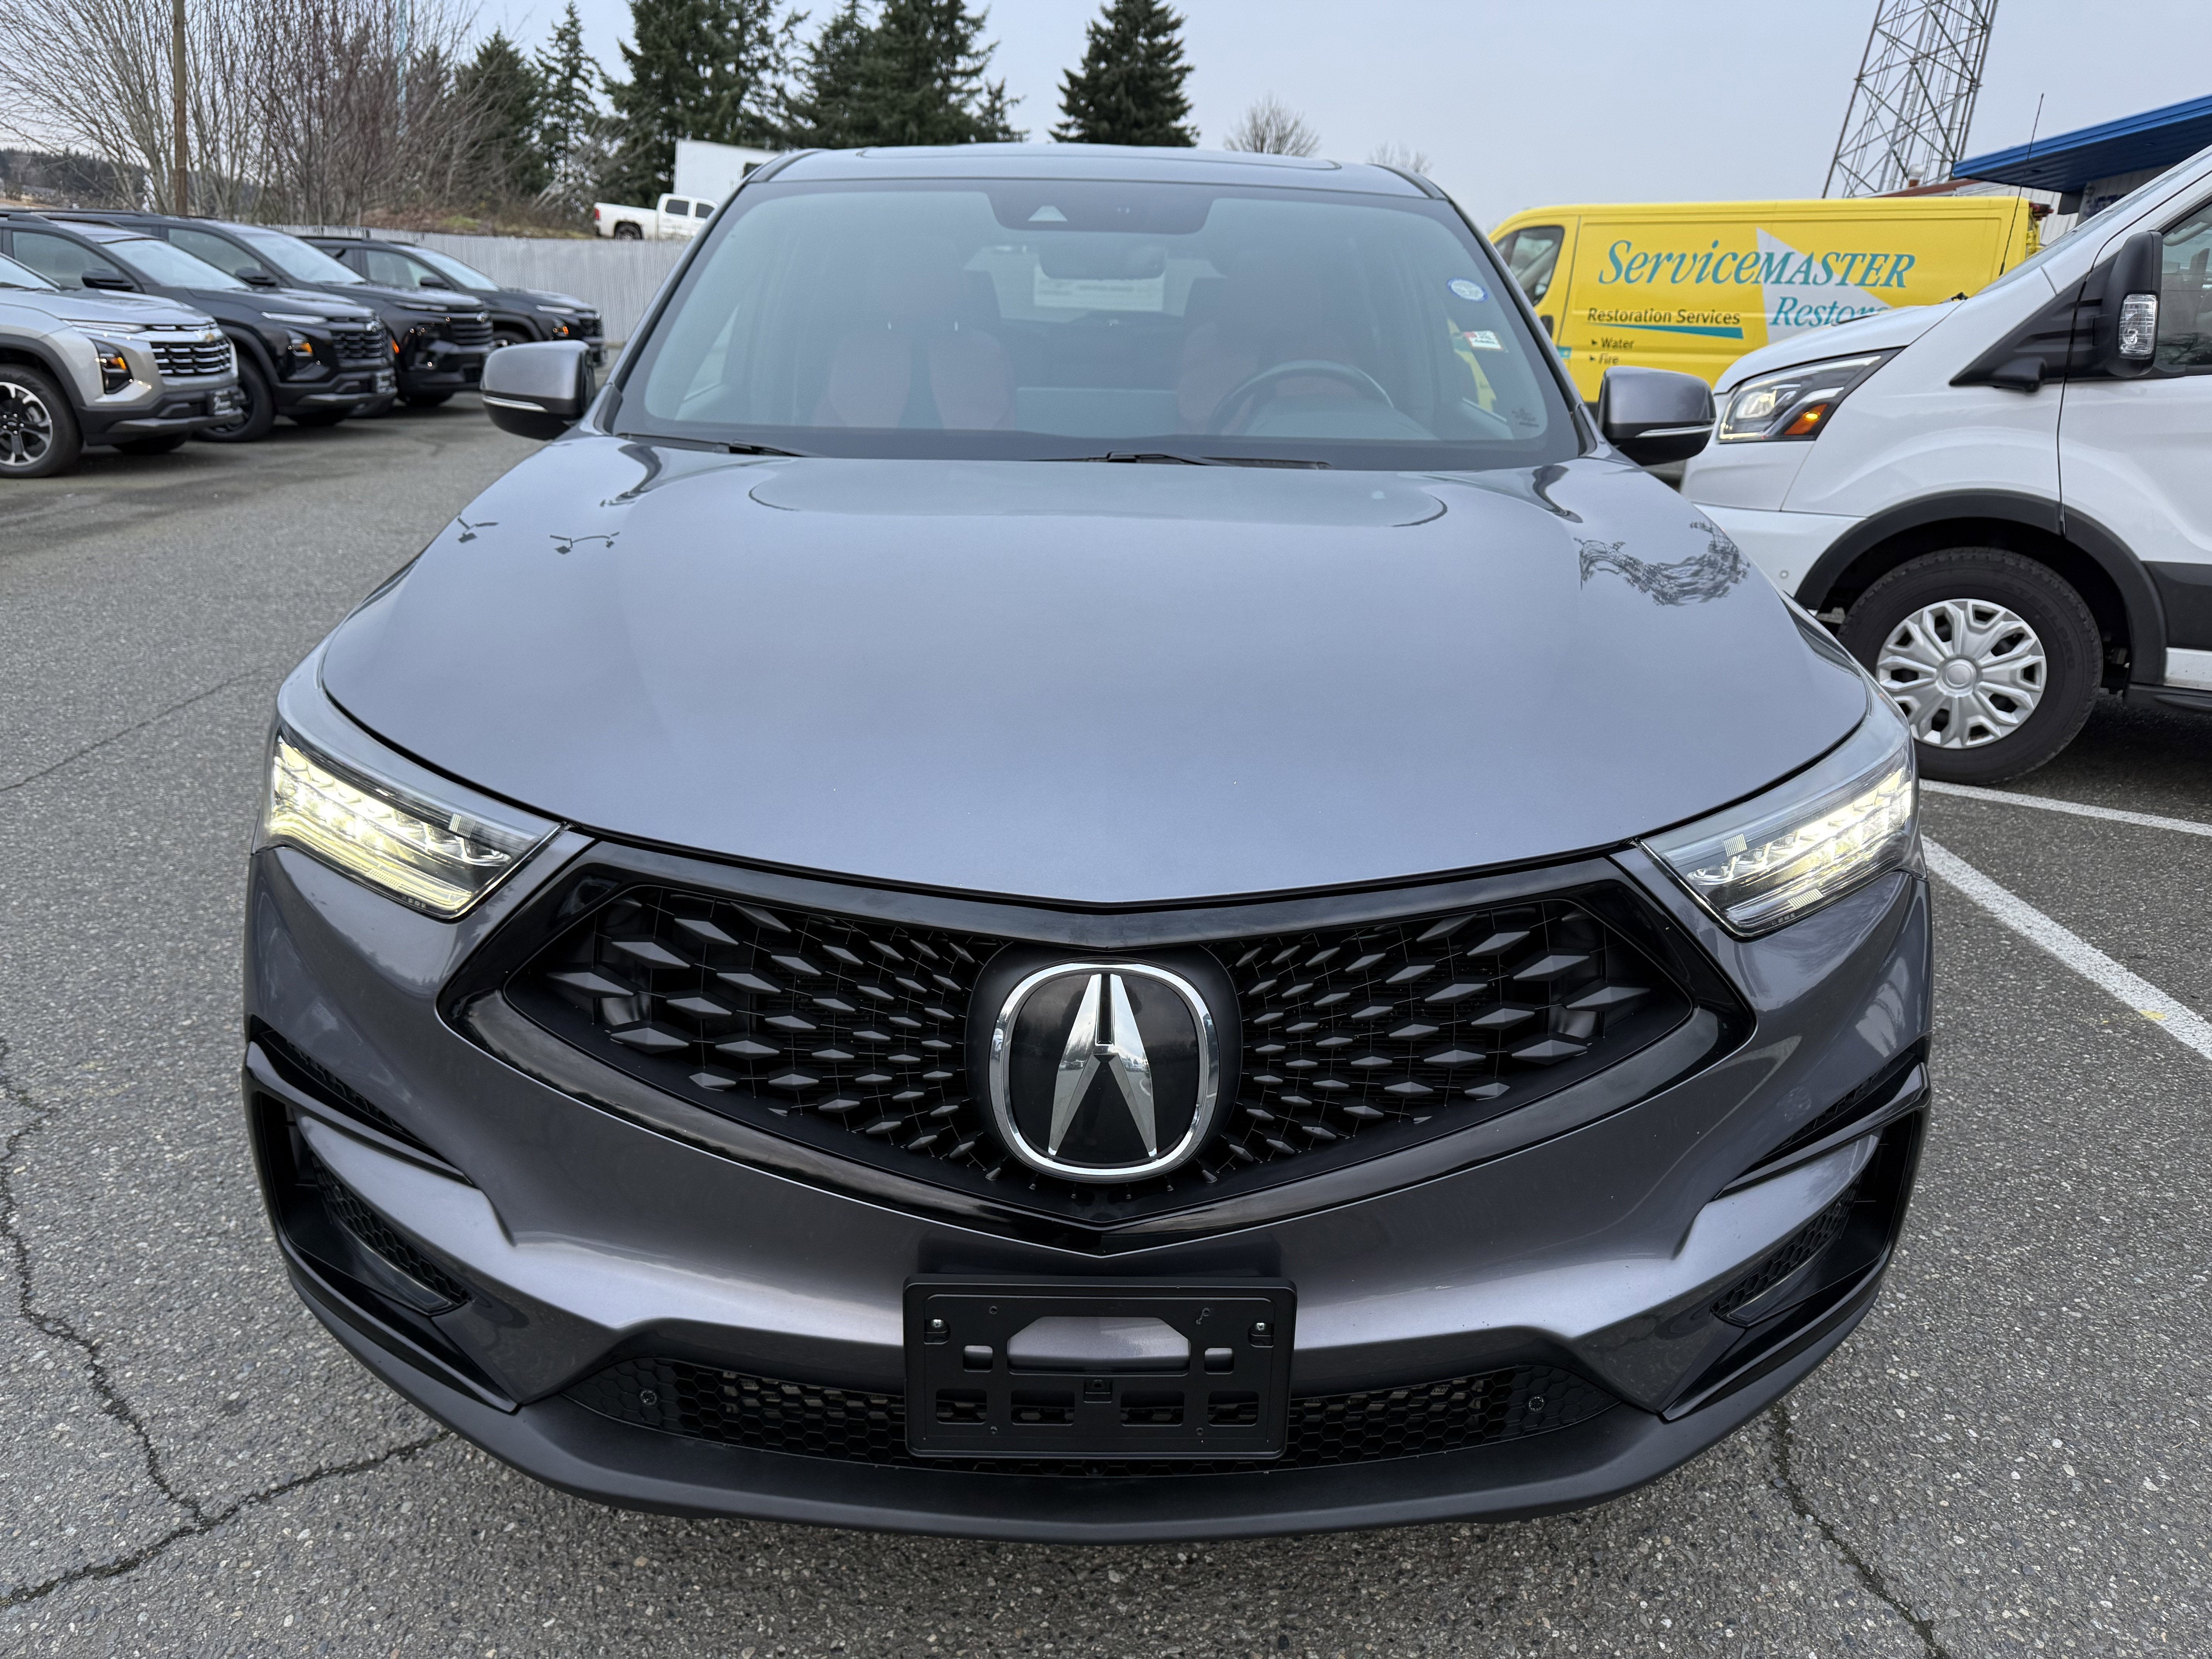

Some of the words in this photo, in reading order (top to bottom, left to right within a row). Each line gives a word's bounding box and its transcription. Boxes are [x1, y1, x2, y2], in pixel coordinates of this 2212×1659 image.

[1599, 239, 1915, 288] ServiceMASTER
[1587, 307, 1671, 323] Restoration
[1676, 309, 1740, 325] Services
[1601, 337, 1635, 350] Water
[1599, 353, 1619, 365] Fire
